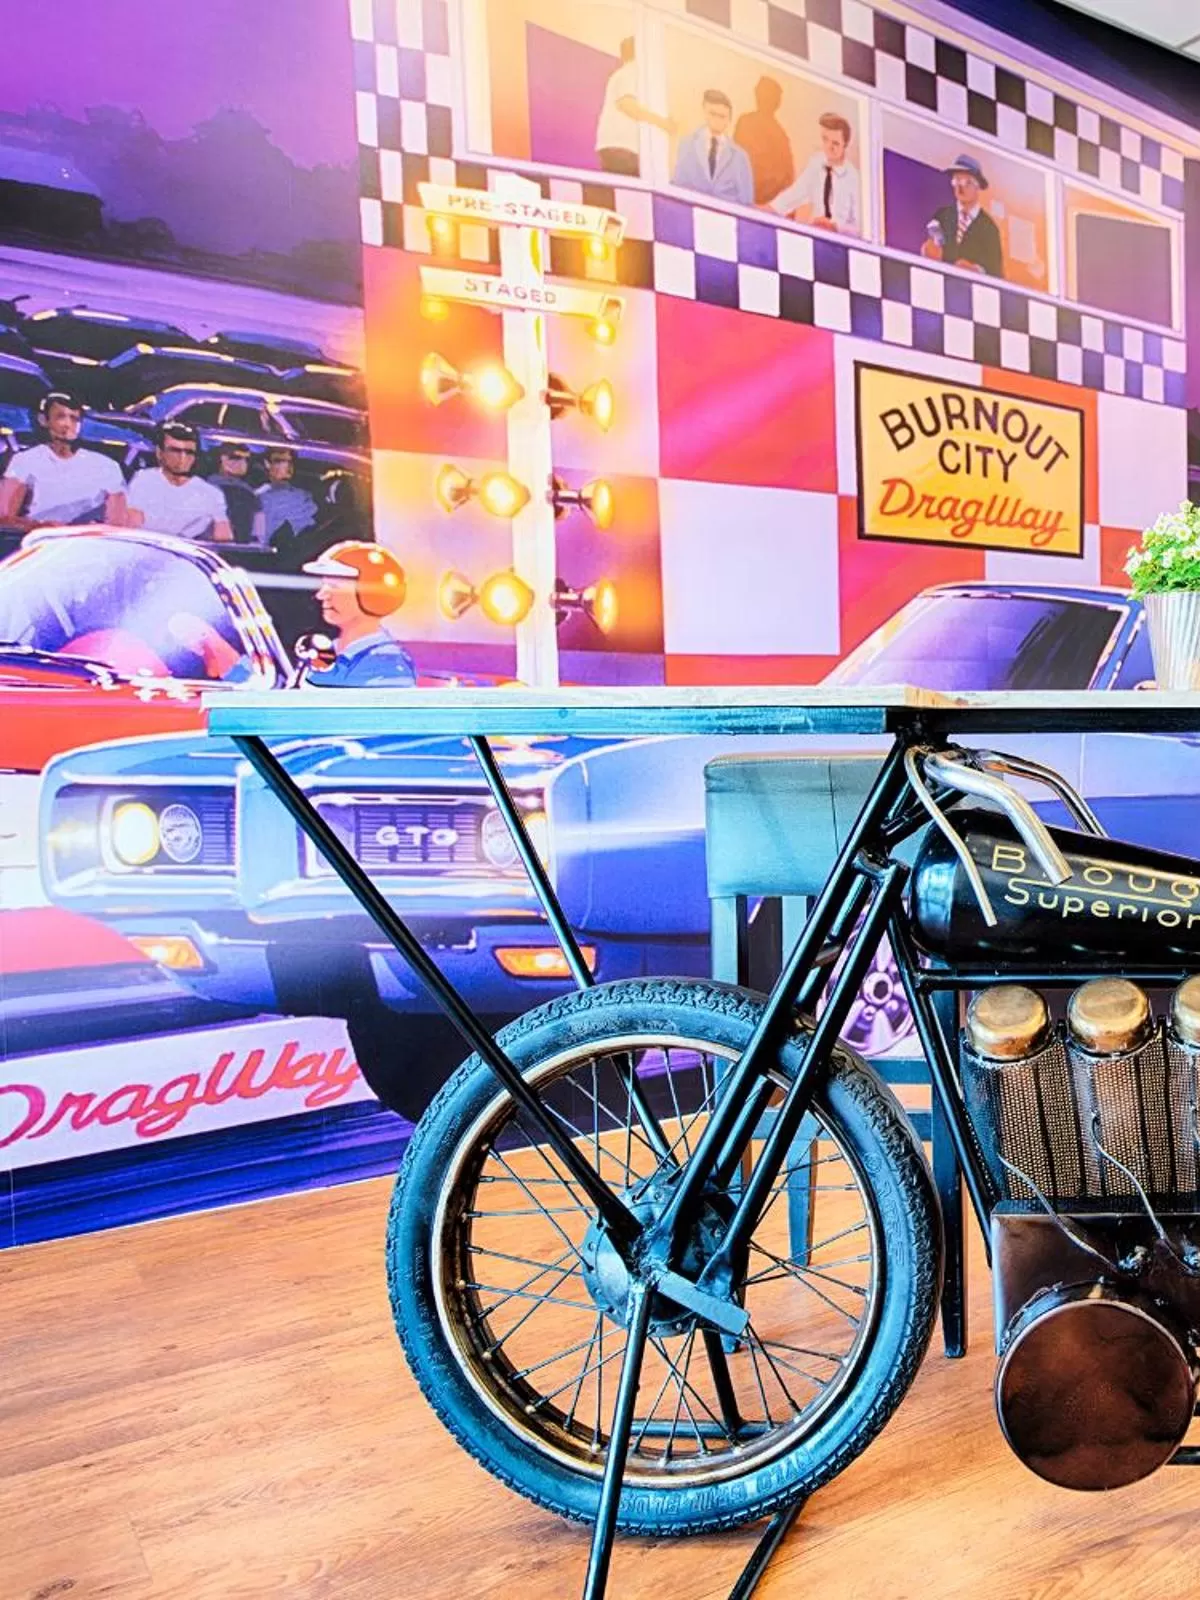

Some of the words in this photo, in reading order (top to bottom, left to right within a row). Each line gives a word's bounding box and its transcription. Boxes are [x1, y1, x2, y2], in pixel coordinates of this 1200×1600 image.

[447, 194, 588, 226] PRE-STAGED
[463, 277, 557, 305] STAGED
[878, 392, 1070, 474] BURNOUT
[938, 438, 1018, 483] CITY
[375, 824, 459, 847] GTO
